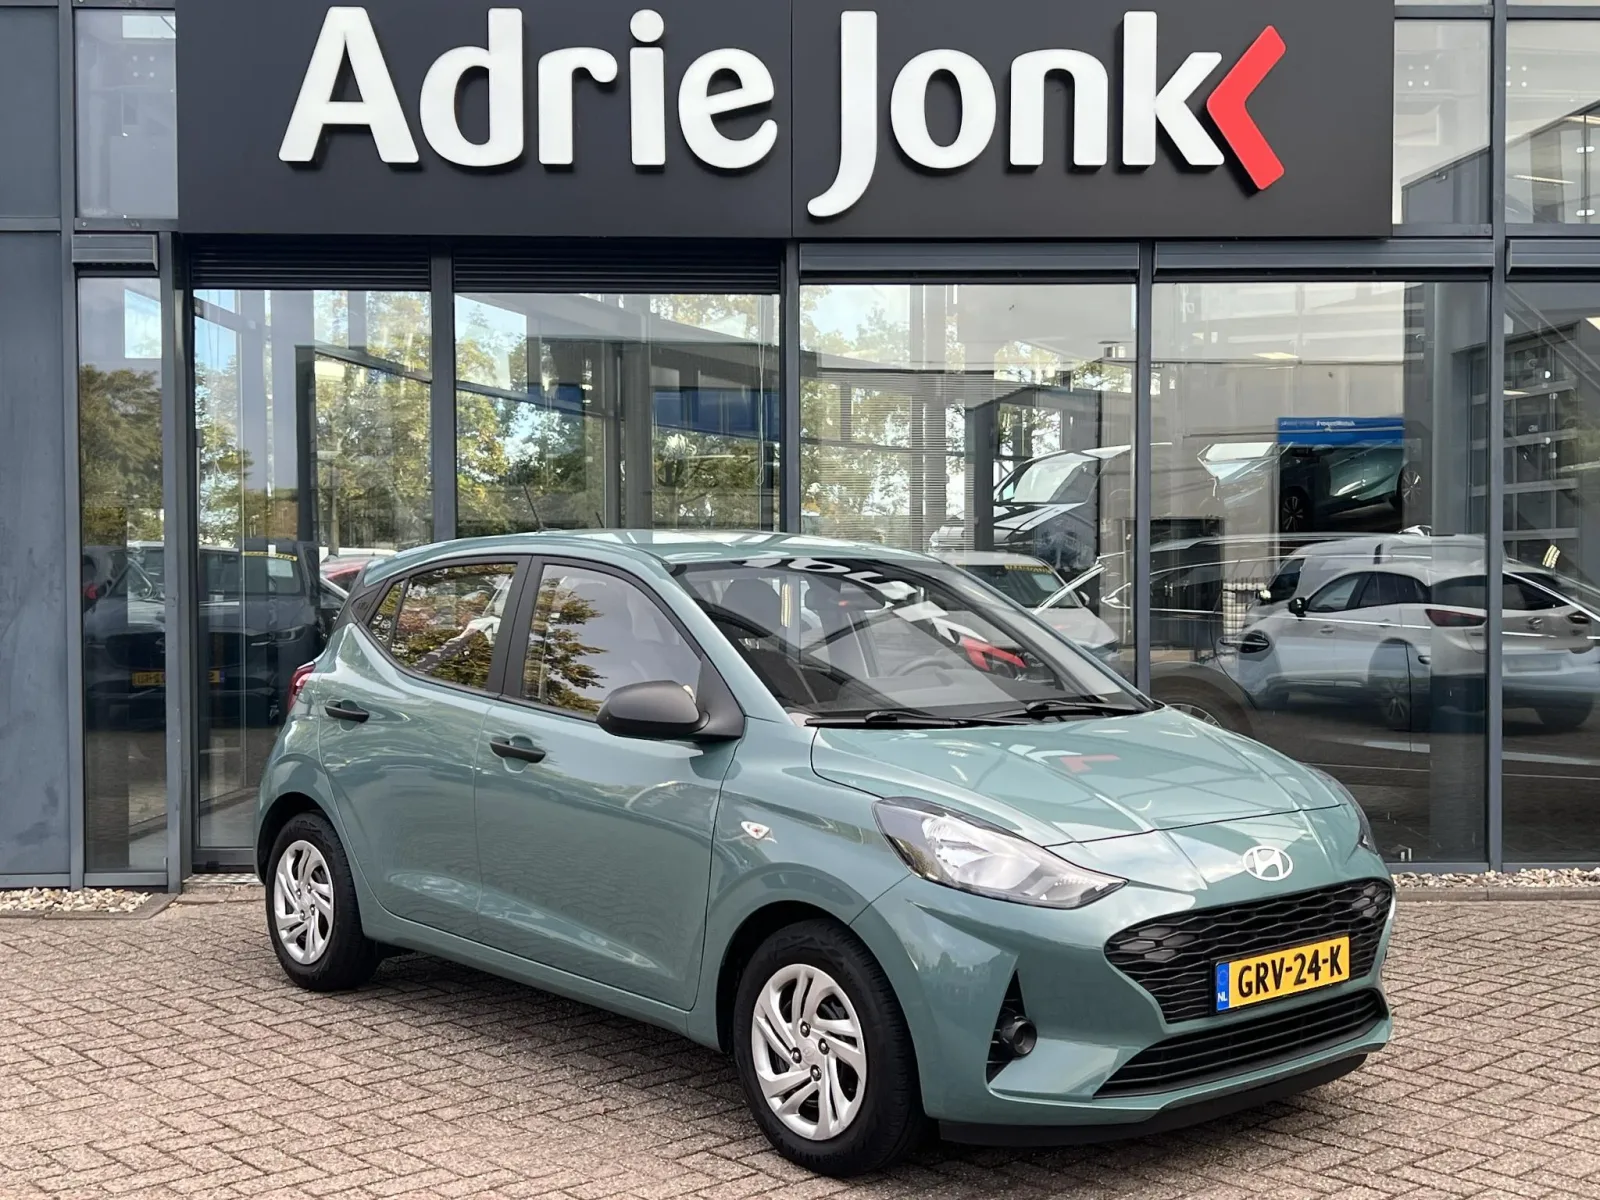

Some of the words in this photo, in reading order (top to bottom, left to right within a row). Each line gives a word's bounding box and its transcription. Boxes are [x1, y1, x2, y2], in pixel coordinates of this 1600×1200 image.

[279, 7, 778, 169] Adrie
[808, 11, 1225, 217] Jonk
[1217, 991, 1228, 1003] NL
[1238, 944, 1343, 998] GRV-24-K
